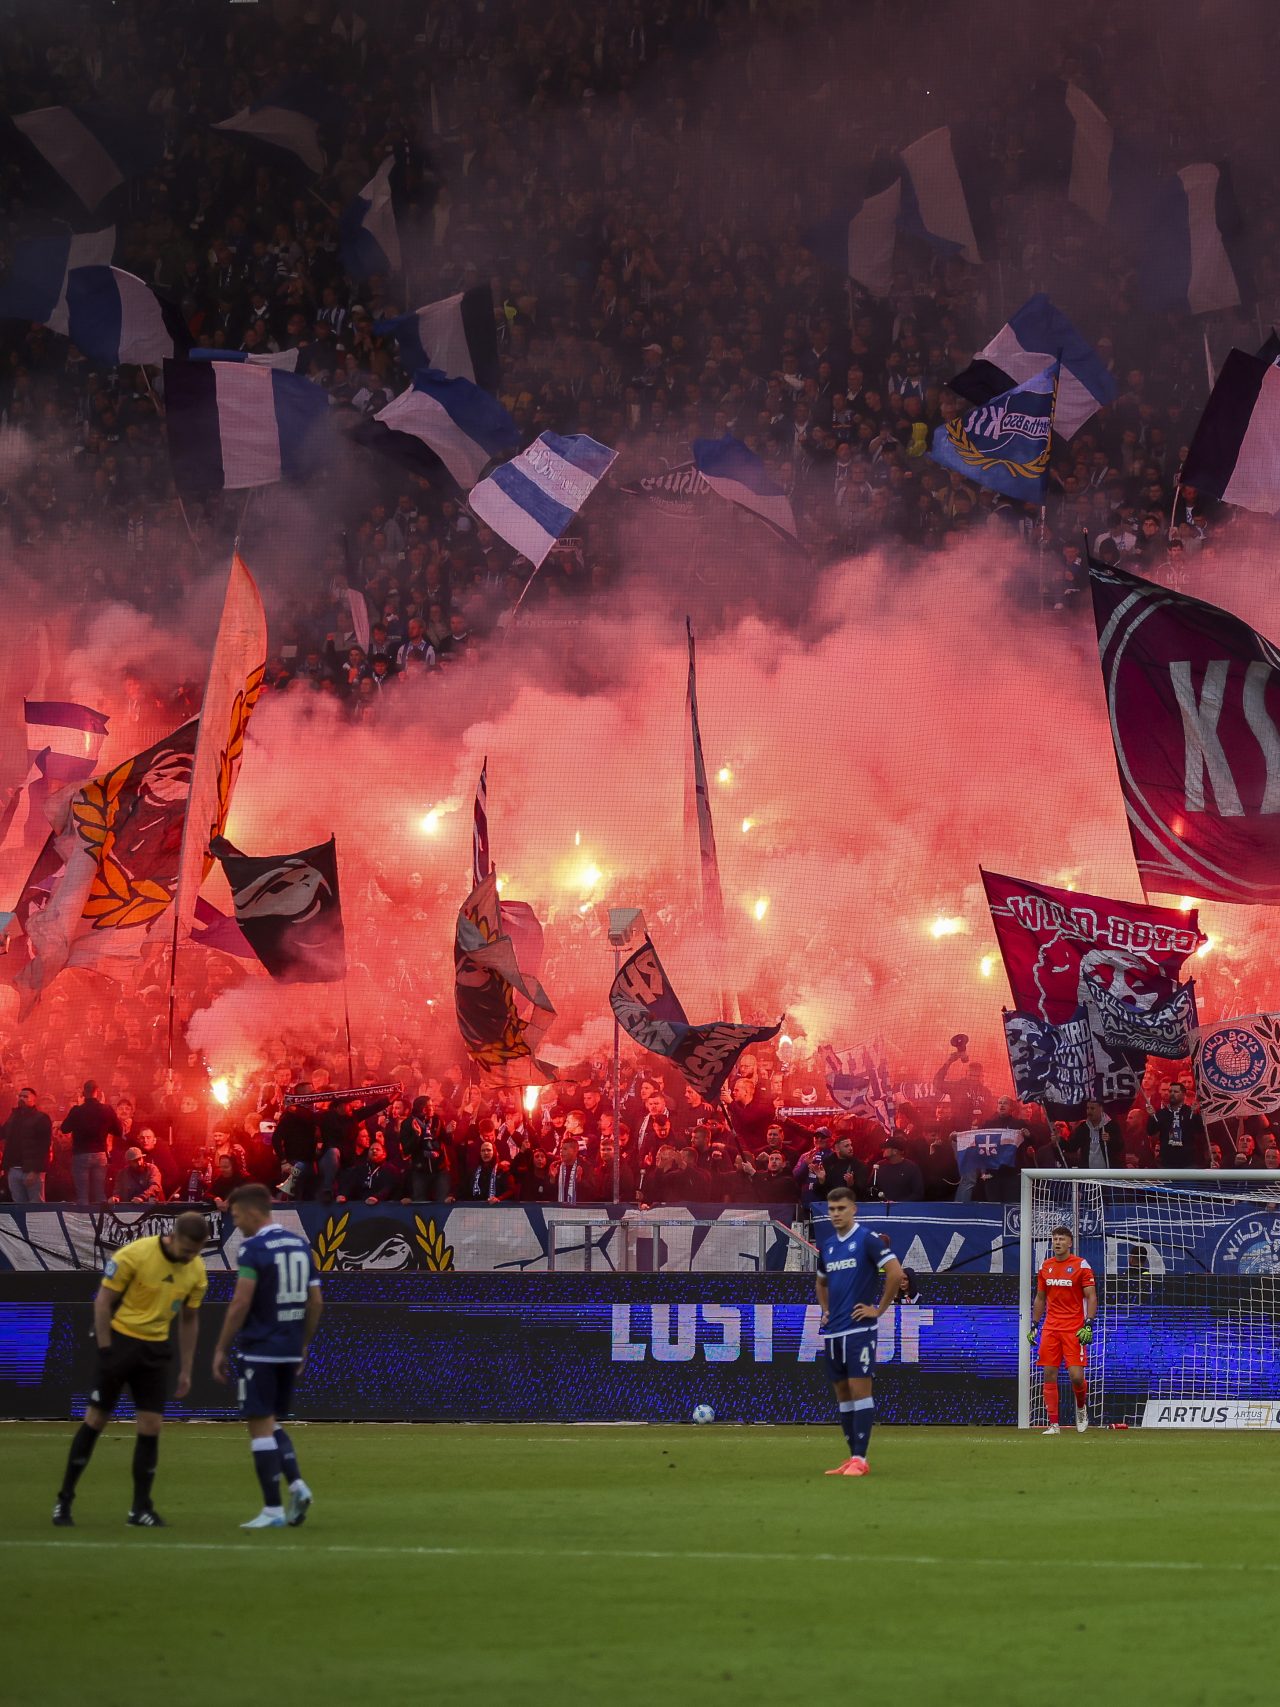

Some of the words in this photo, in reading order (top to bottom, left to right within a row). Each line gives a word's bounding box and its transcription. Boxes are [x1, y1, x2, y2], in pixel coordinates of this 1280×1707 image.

[1204, 1034, 1225, 1063] WILD
[1228, 1031, 1260, 1054] BOYS
[1207, 1058, 1265, 1090] KARLSRUHE
[1222, 1220, 1263, 1261] WILD
[274, 1251, 310, 1304] 10
[825, 1257, 858, 1273] SWEG
[1045, 1278, 1073, 1287] SWEG
[859, 1346, 871, 1366] 4
[1158, 1406, 1229, 1423] ARTUS
[1233, 1410, 1263, 1419] ARTUS
